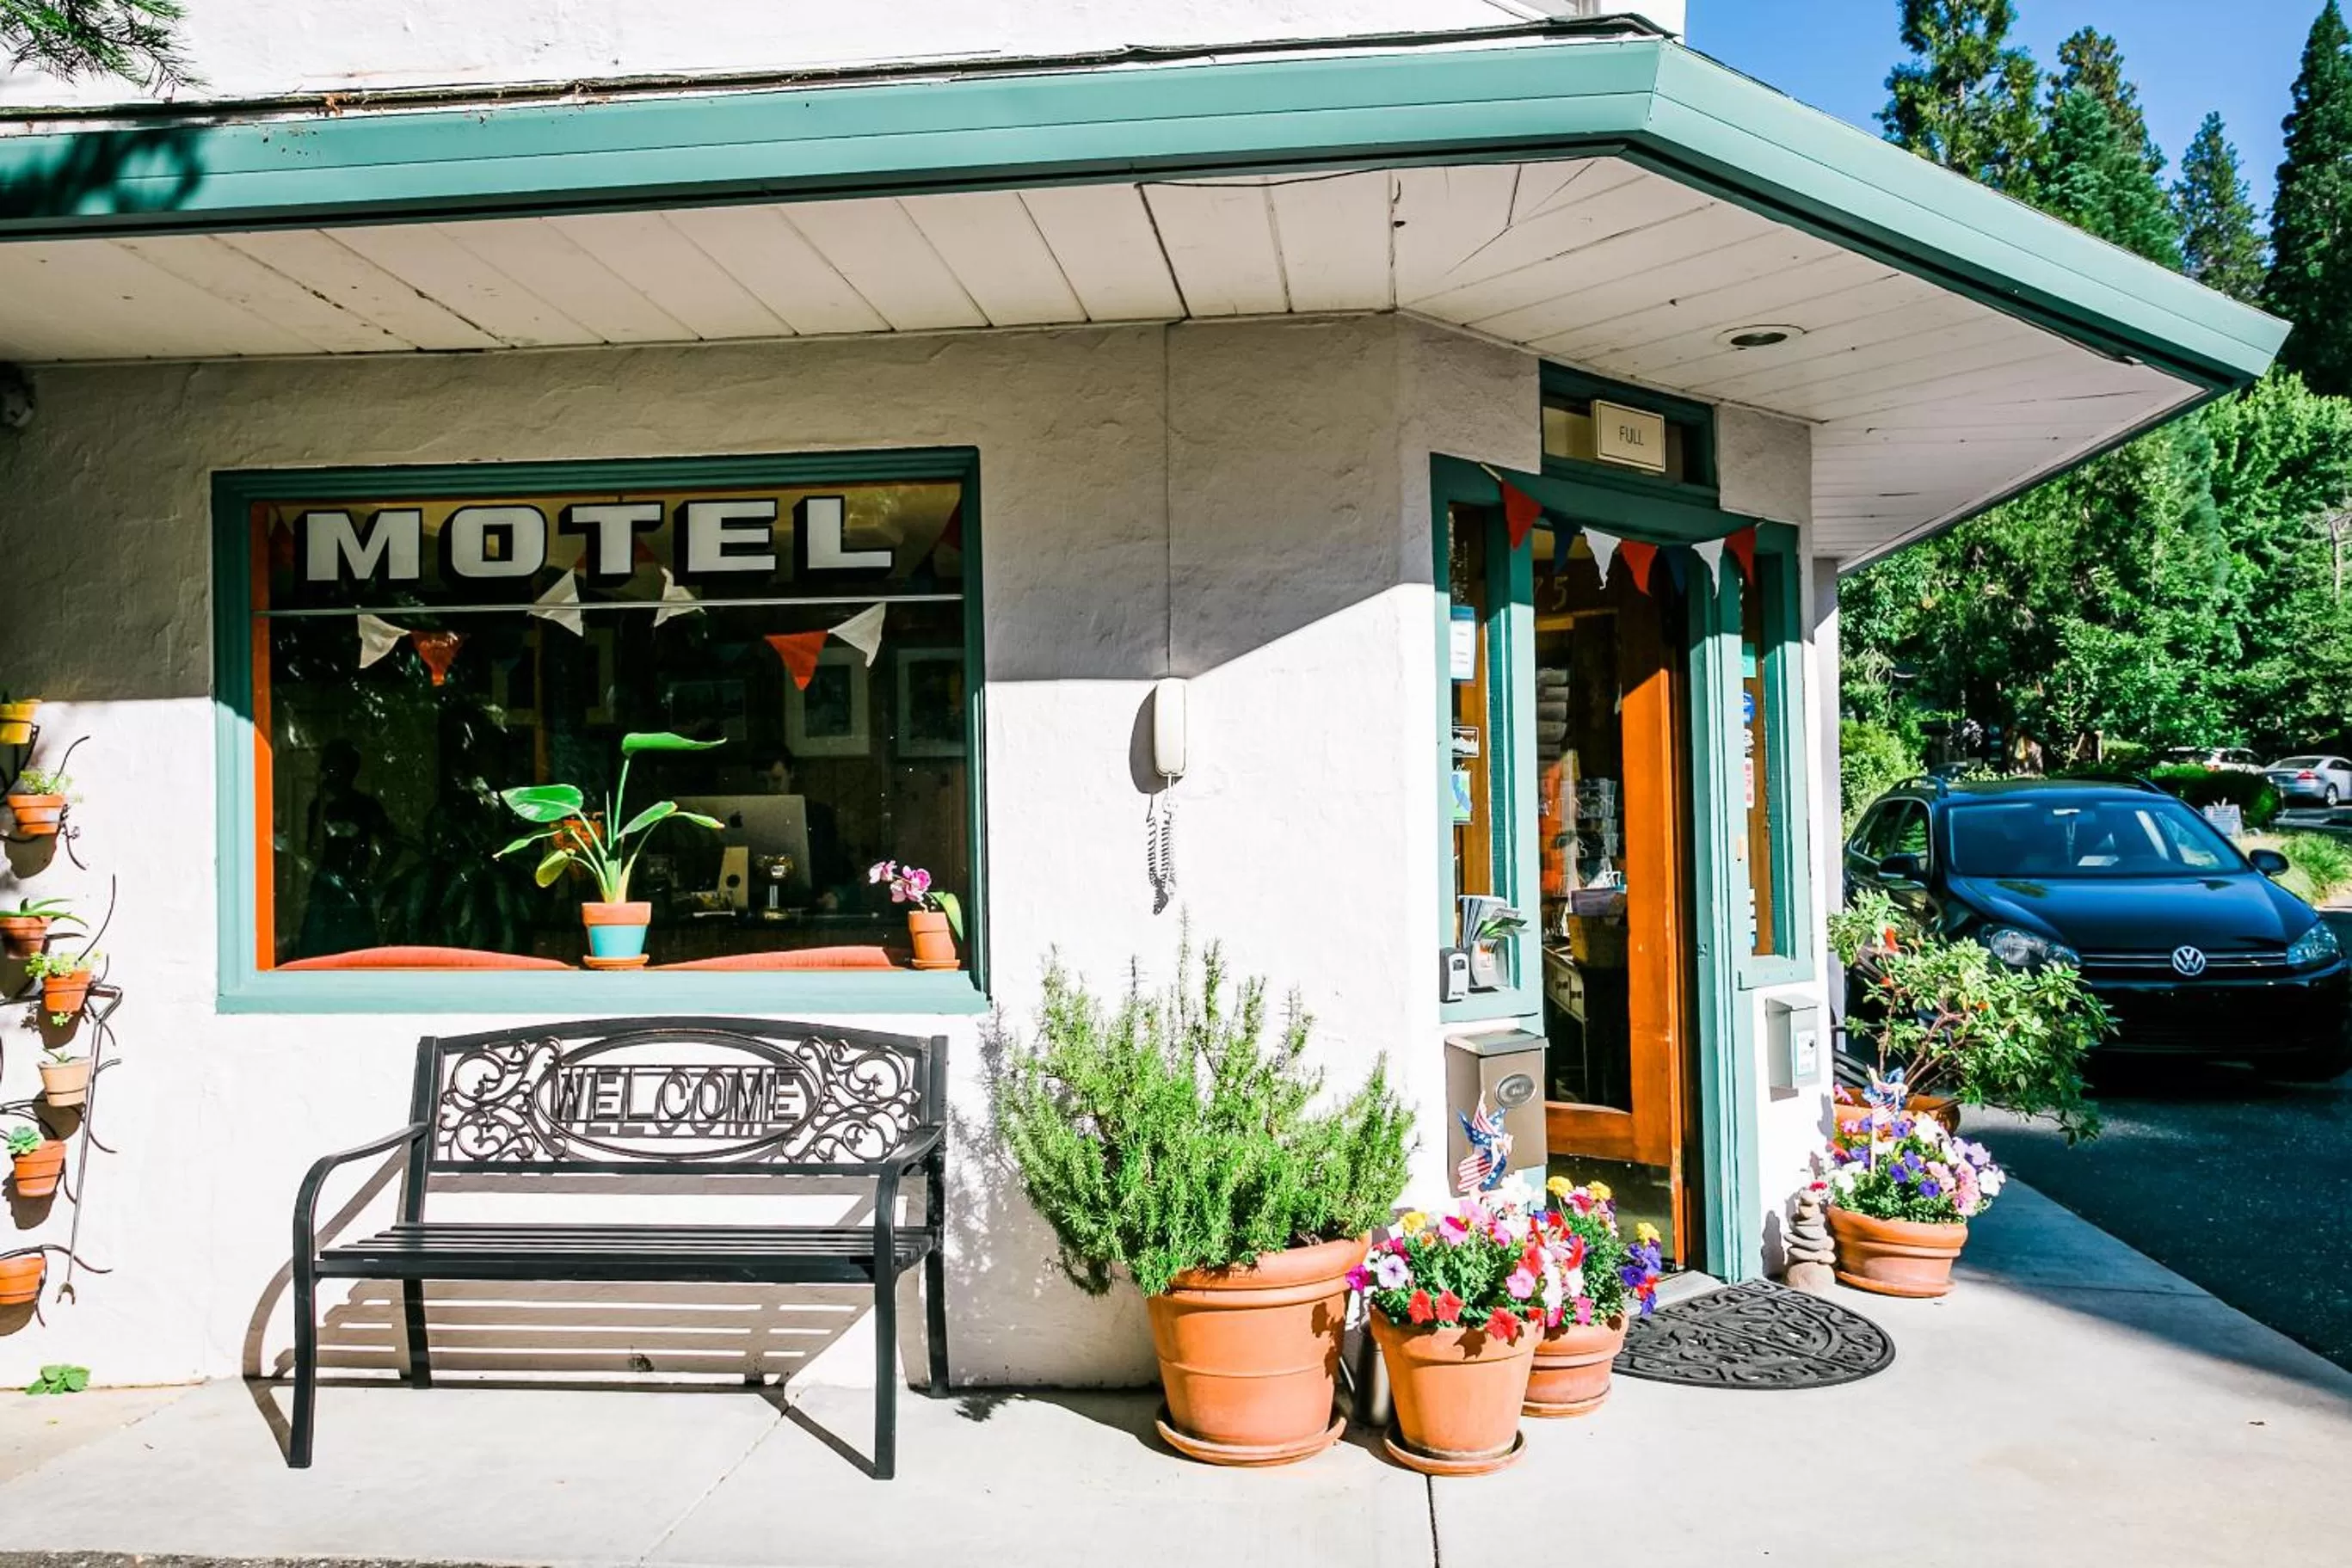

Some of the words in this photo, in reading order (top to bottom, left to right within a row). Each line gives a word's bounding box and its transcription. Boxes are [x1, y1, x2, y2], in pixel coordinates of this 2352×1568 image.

[1619, 425, 1645, 446] FULL
[298, 495, 894, 587] MOTEL
[2173, 946, 2205, 975] VW
[551, 1066, 800, 1122] WELCOME
